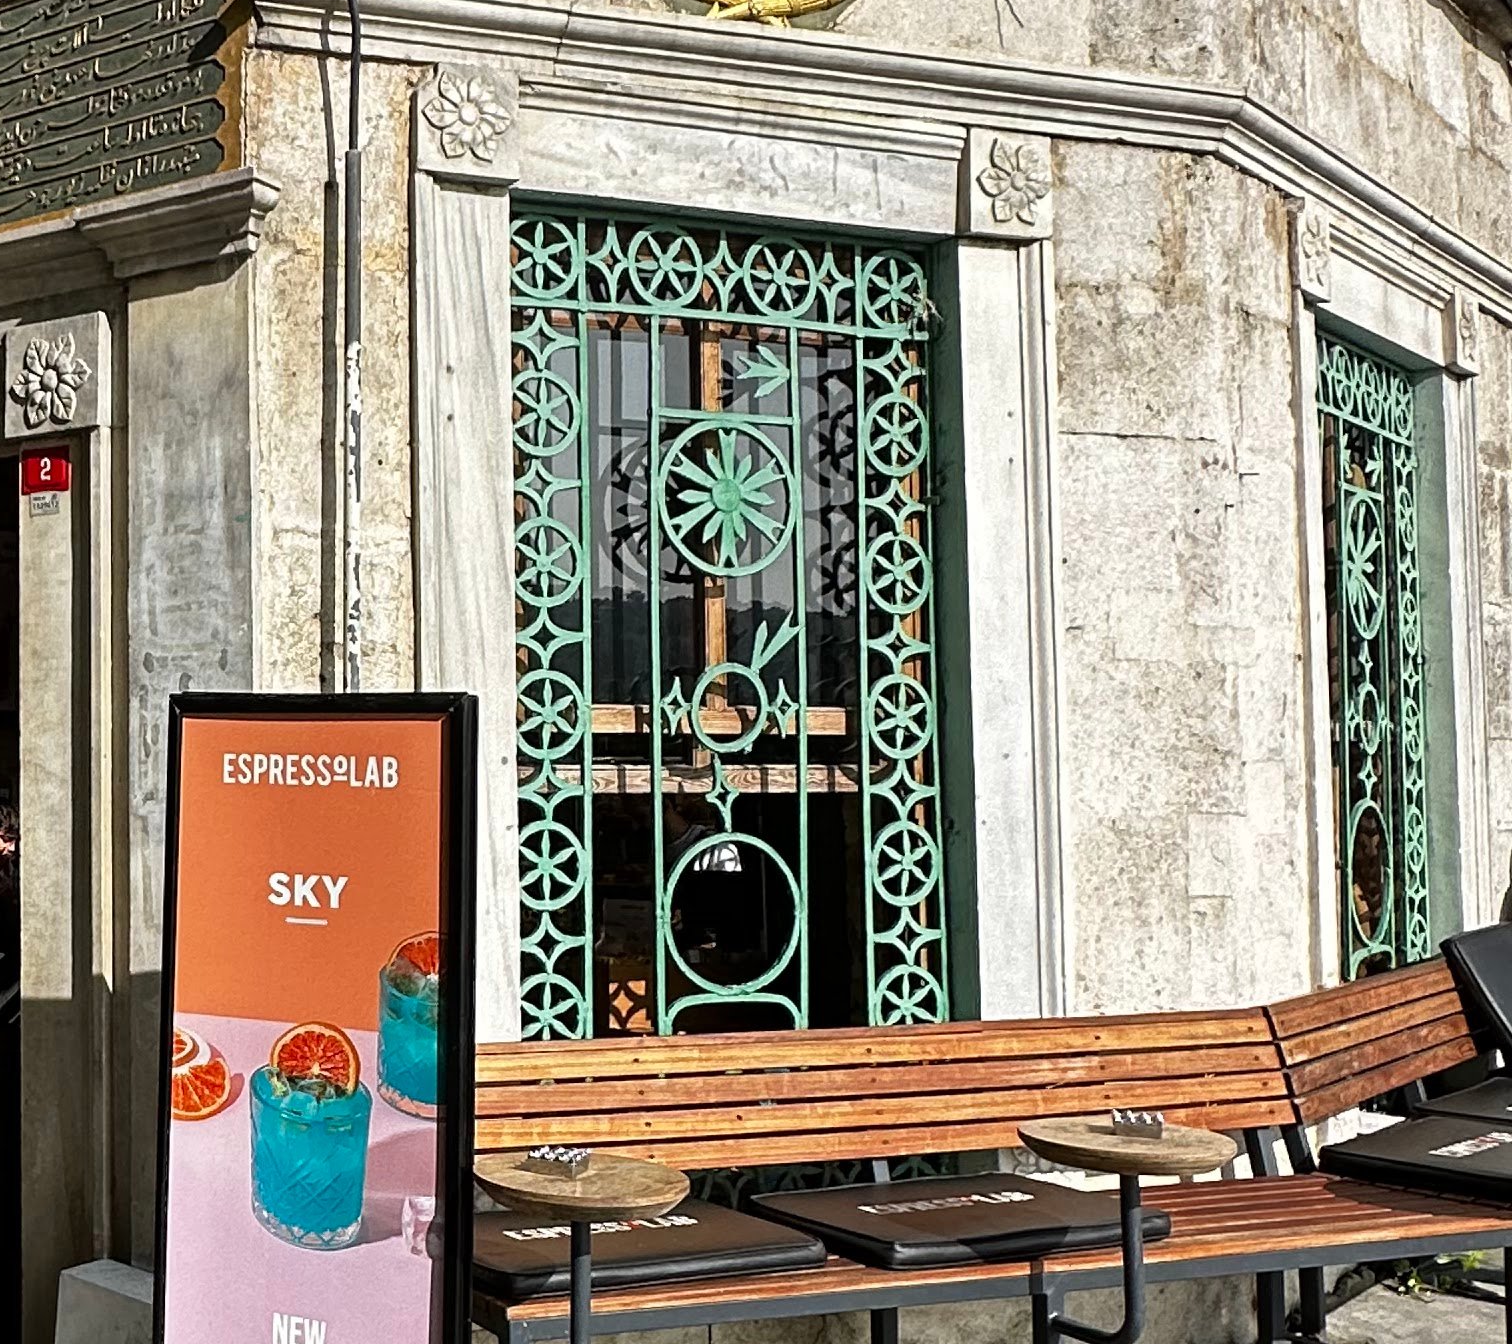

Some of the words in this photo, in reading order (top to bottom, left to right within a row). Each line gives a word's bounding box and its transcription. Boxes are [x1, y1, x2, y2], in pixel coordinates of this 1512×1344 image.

[40, 457, 51, 481] 2
[222, 753, 399, 789] ESPRESSOLAB
[267, 871, 348, 910] SKY
